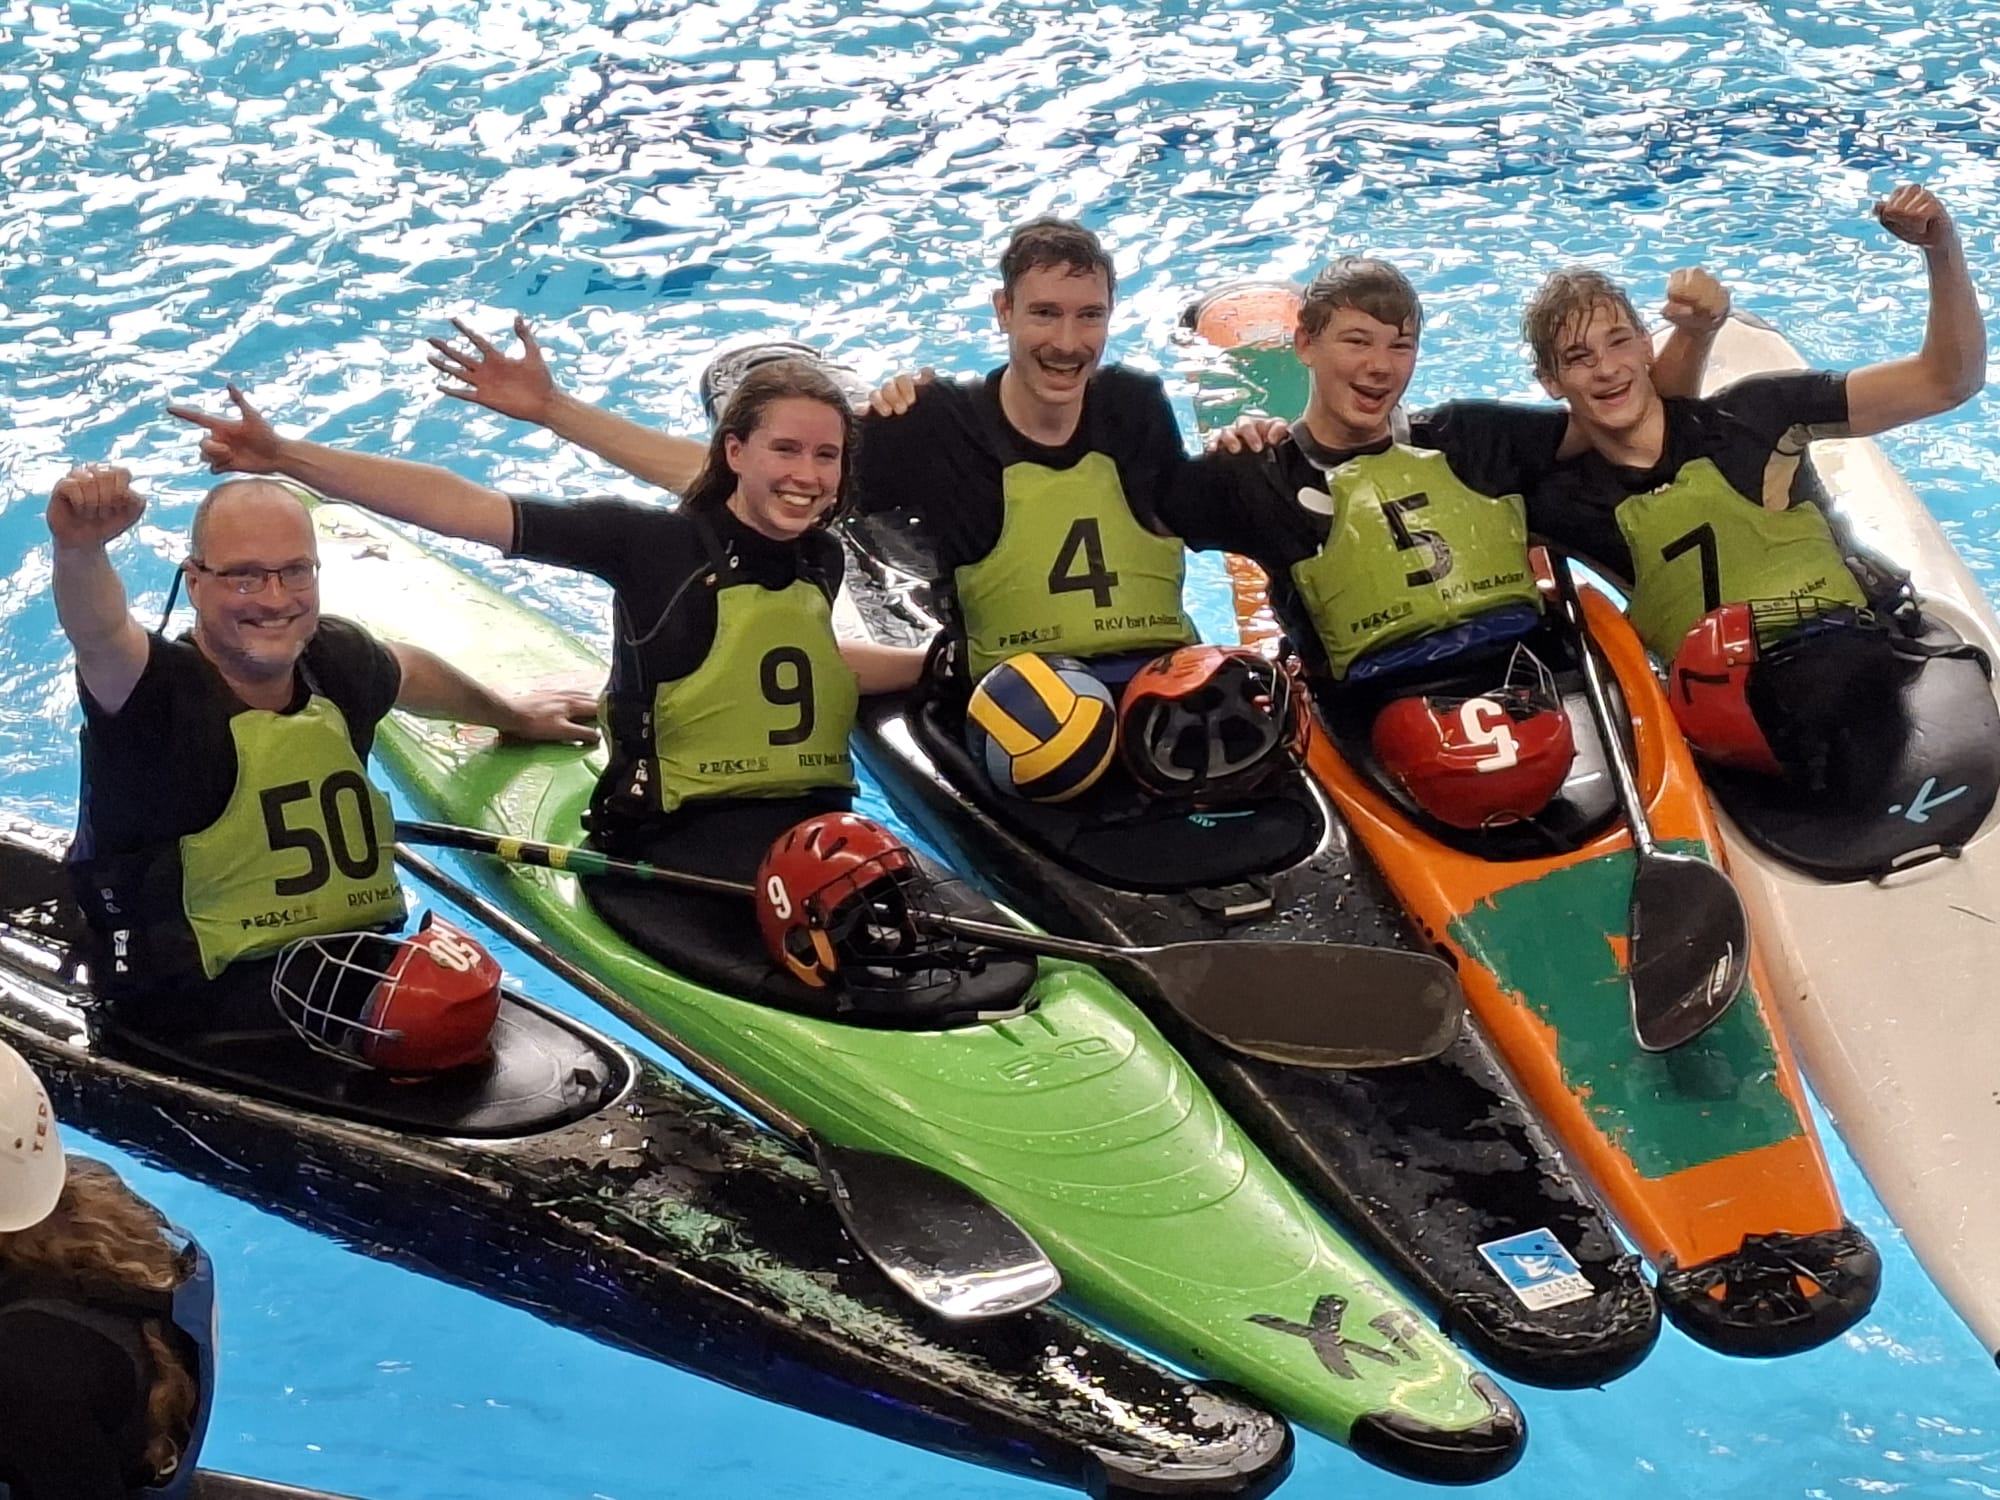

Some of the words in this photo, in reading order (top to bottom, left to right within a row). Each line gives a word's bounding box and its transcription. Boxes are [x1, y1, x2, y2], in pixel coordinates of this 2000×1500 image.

[1048, 517, 1119, 608] 4
[1381, 492, 1454, 588] 5
[1661, 522, 1720, 614] 7
[760, 646, 815, 746] 9
[1461, 698, 1518, 773] 5
[259, 769, 379, 896] 50
[767, 875, 792, 919] 9
